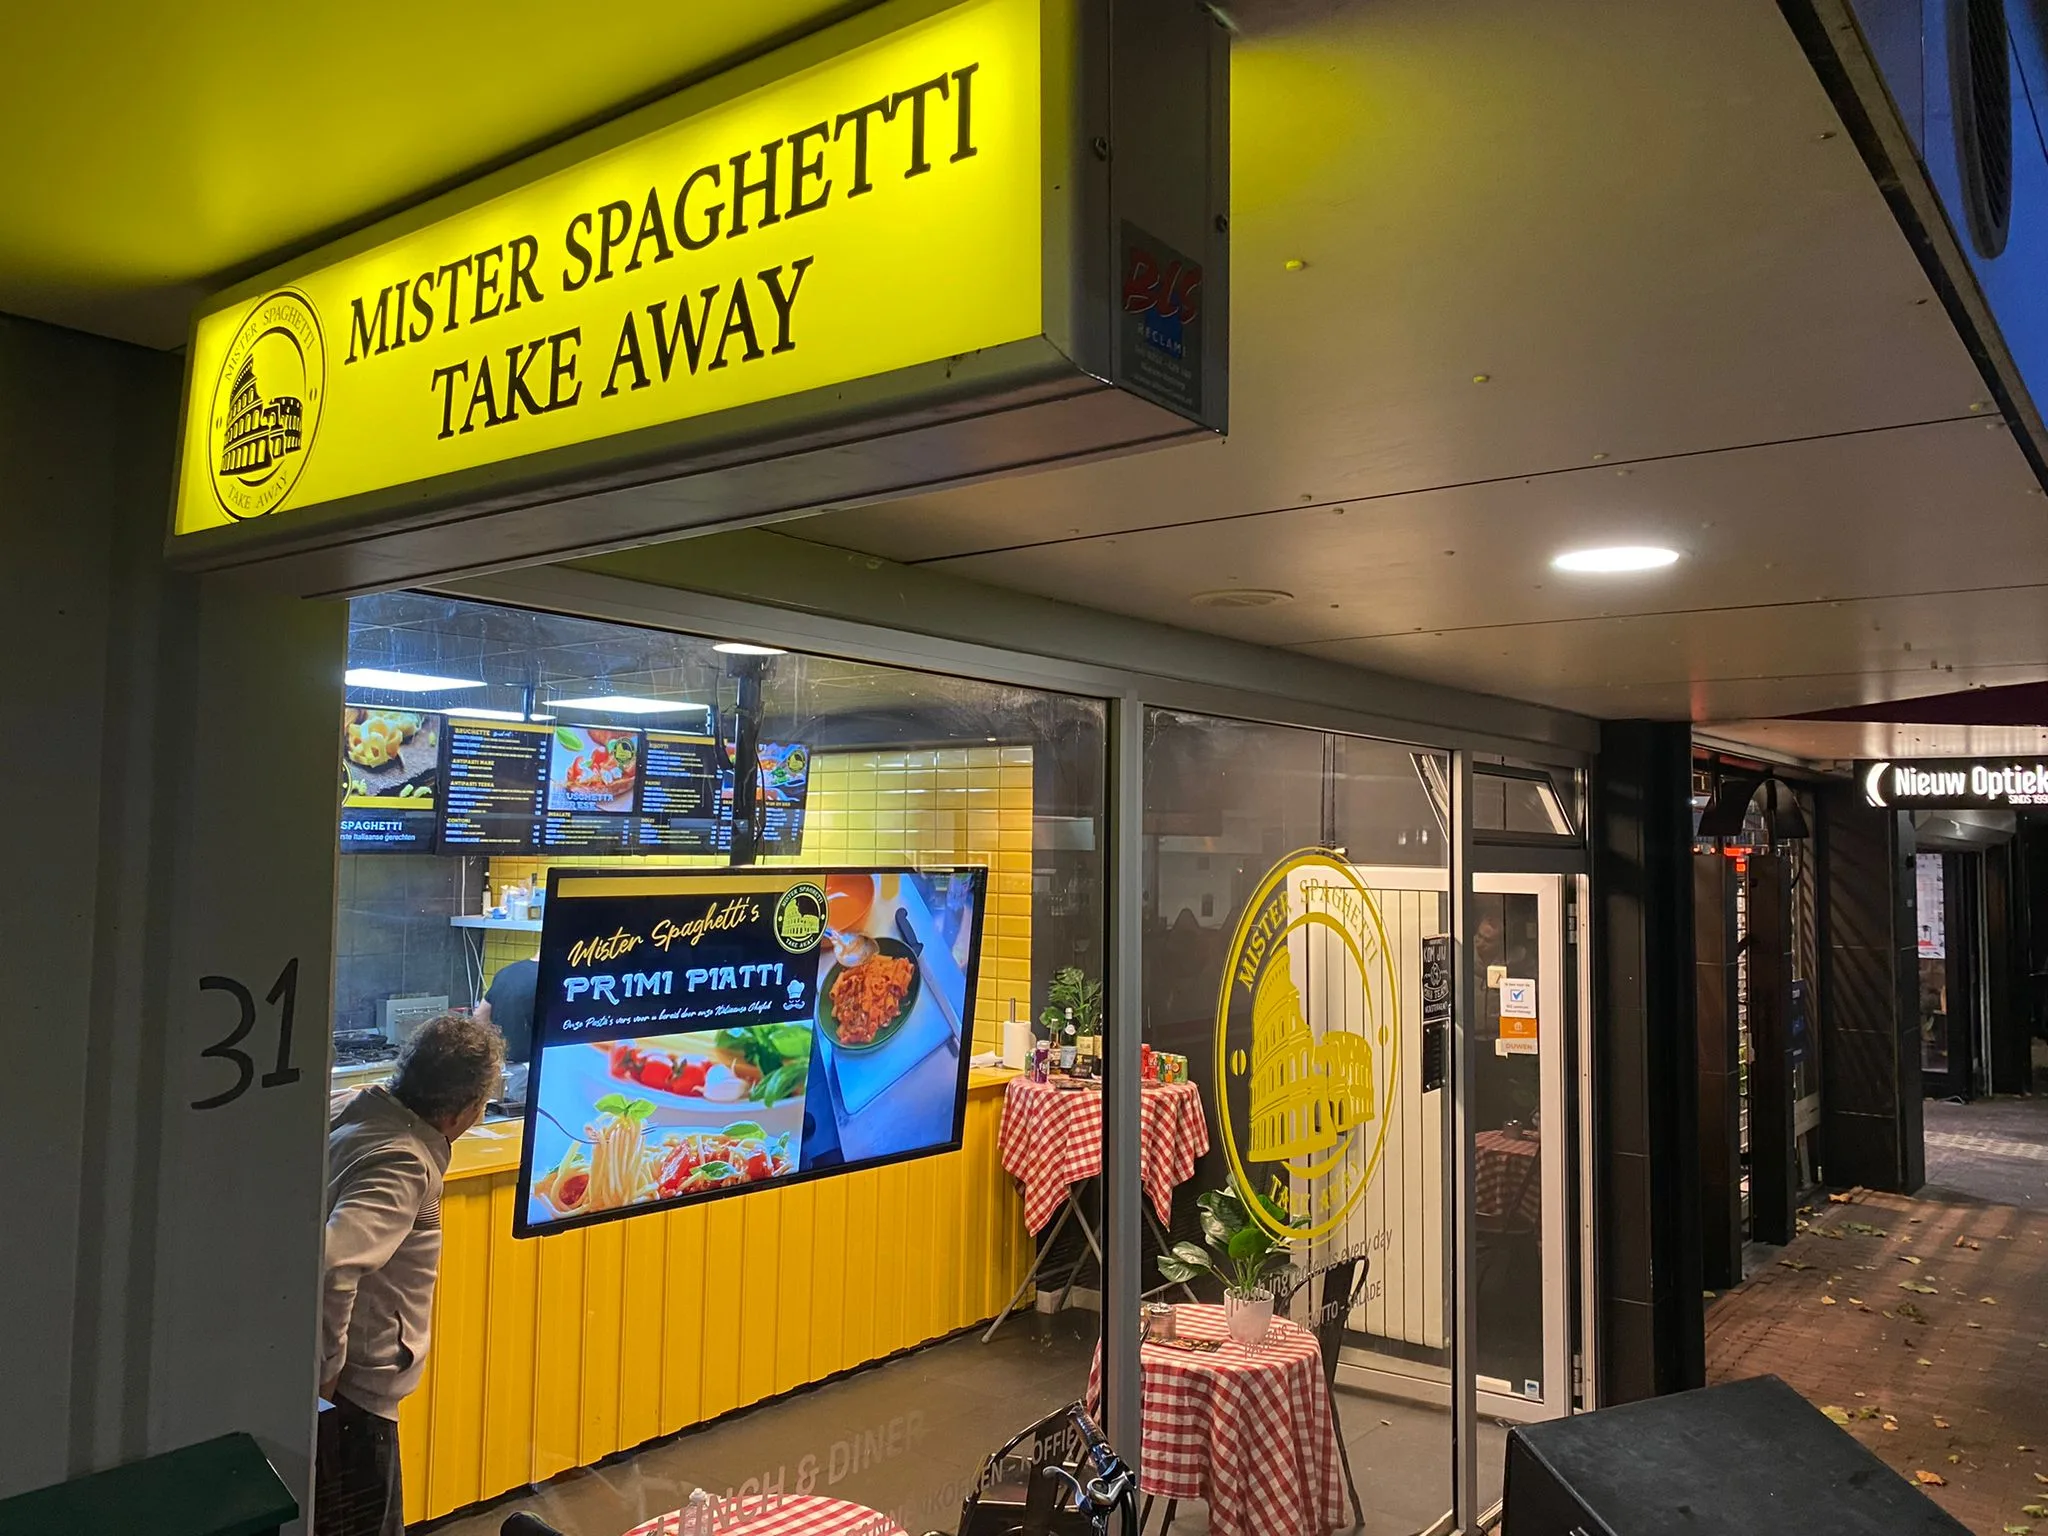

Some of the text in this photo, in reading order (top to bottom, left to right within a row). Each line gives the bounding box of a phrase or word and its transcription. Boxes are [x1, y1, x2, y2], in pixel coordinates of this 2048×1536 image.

[344, 62, 981, 366] MISTER SPAGHETTI
[224, 304, 315, 381] MISTER SPAGHETTI
[431, 255, 814, 442] TAKE AWAY
[229, 469, 289, 510] TAKE AWAY
[1895, 764, 2048, 800] Nieuw Optiek
[340, 820, 402, 831] SPAGHETTI
[567, 896, 760, 968] Mister Spaghetti's
[1239, 878, 1378, 993] MISTER SPAGHETTI
[563, 963, 784, 1006] PRIMI PIATTI
[191, 957, 300, 1110] 31
[1341, 1238, 1372, 1264] every
[1373, 1229, 1393, 1251] day
[1297, 1301, 1339, 1336] RISOTTO
[1347, 1281, 1382, 1312] SALADE
[796, 1453, 820, 1497] &
[828, 1410, 926, 1487] DINER
